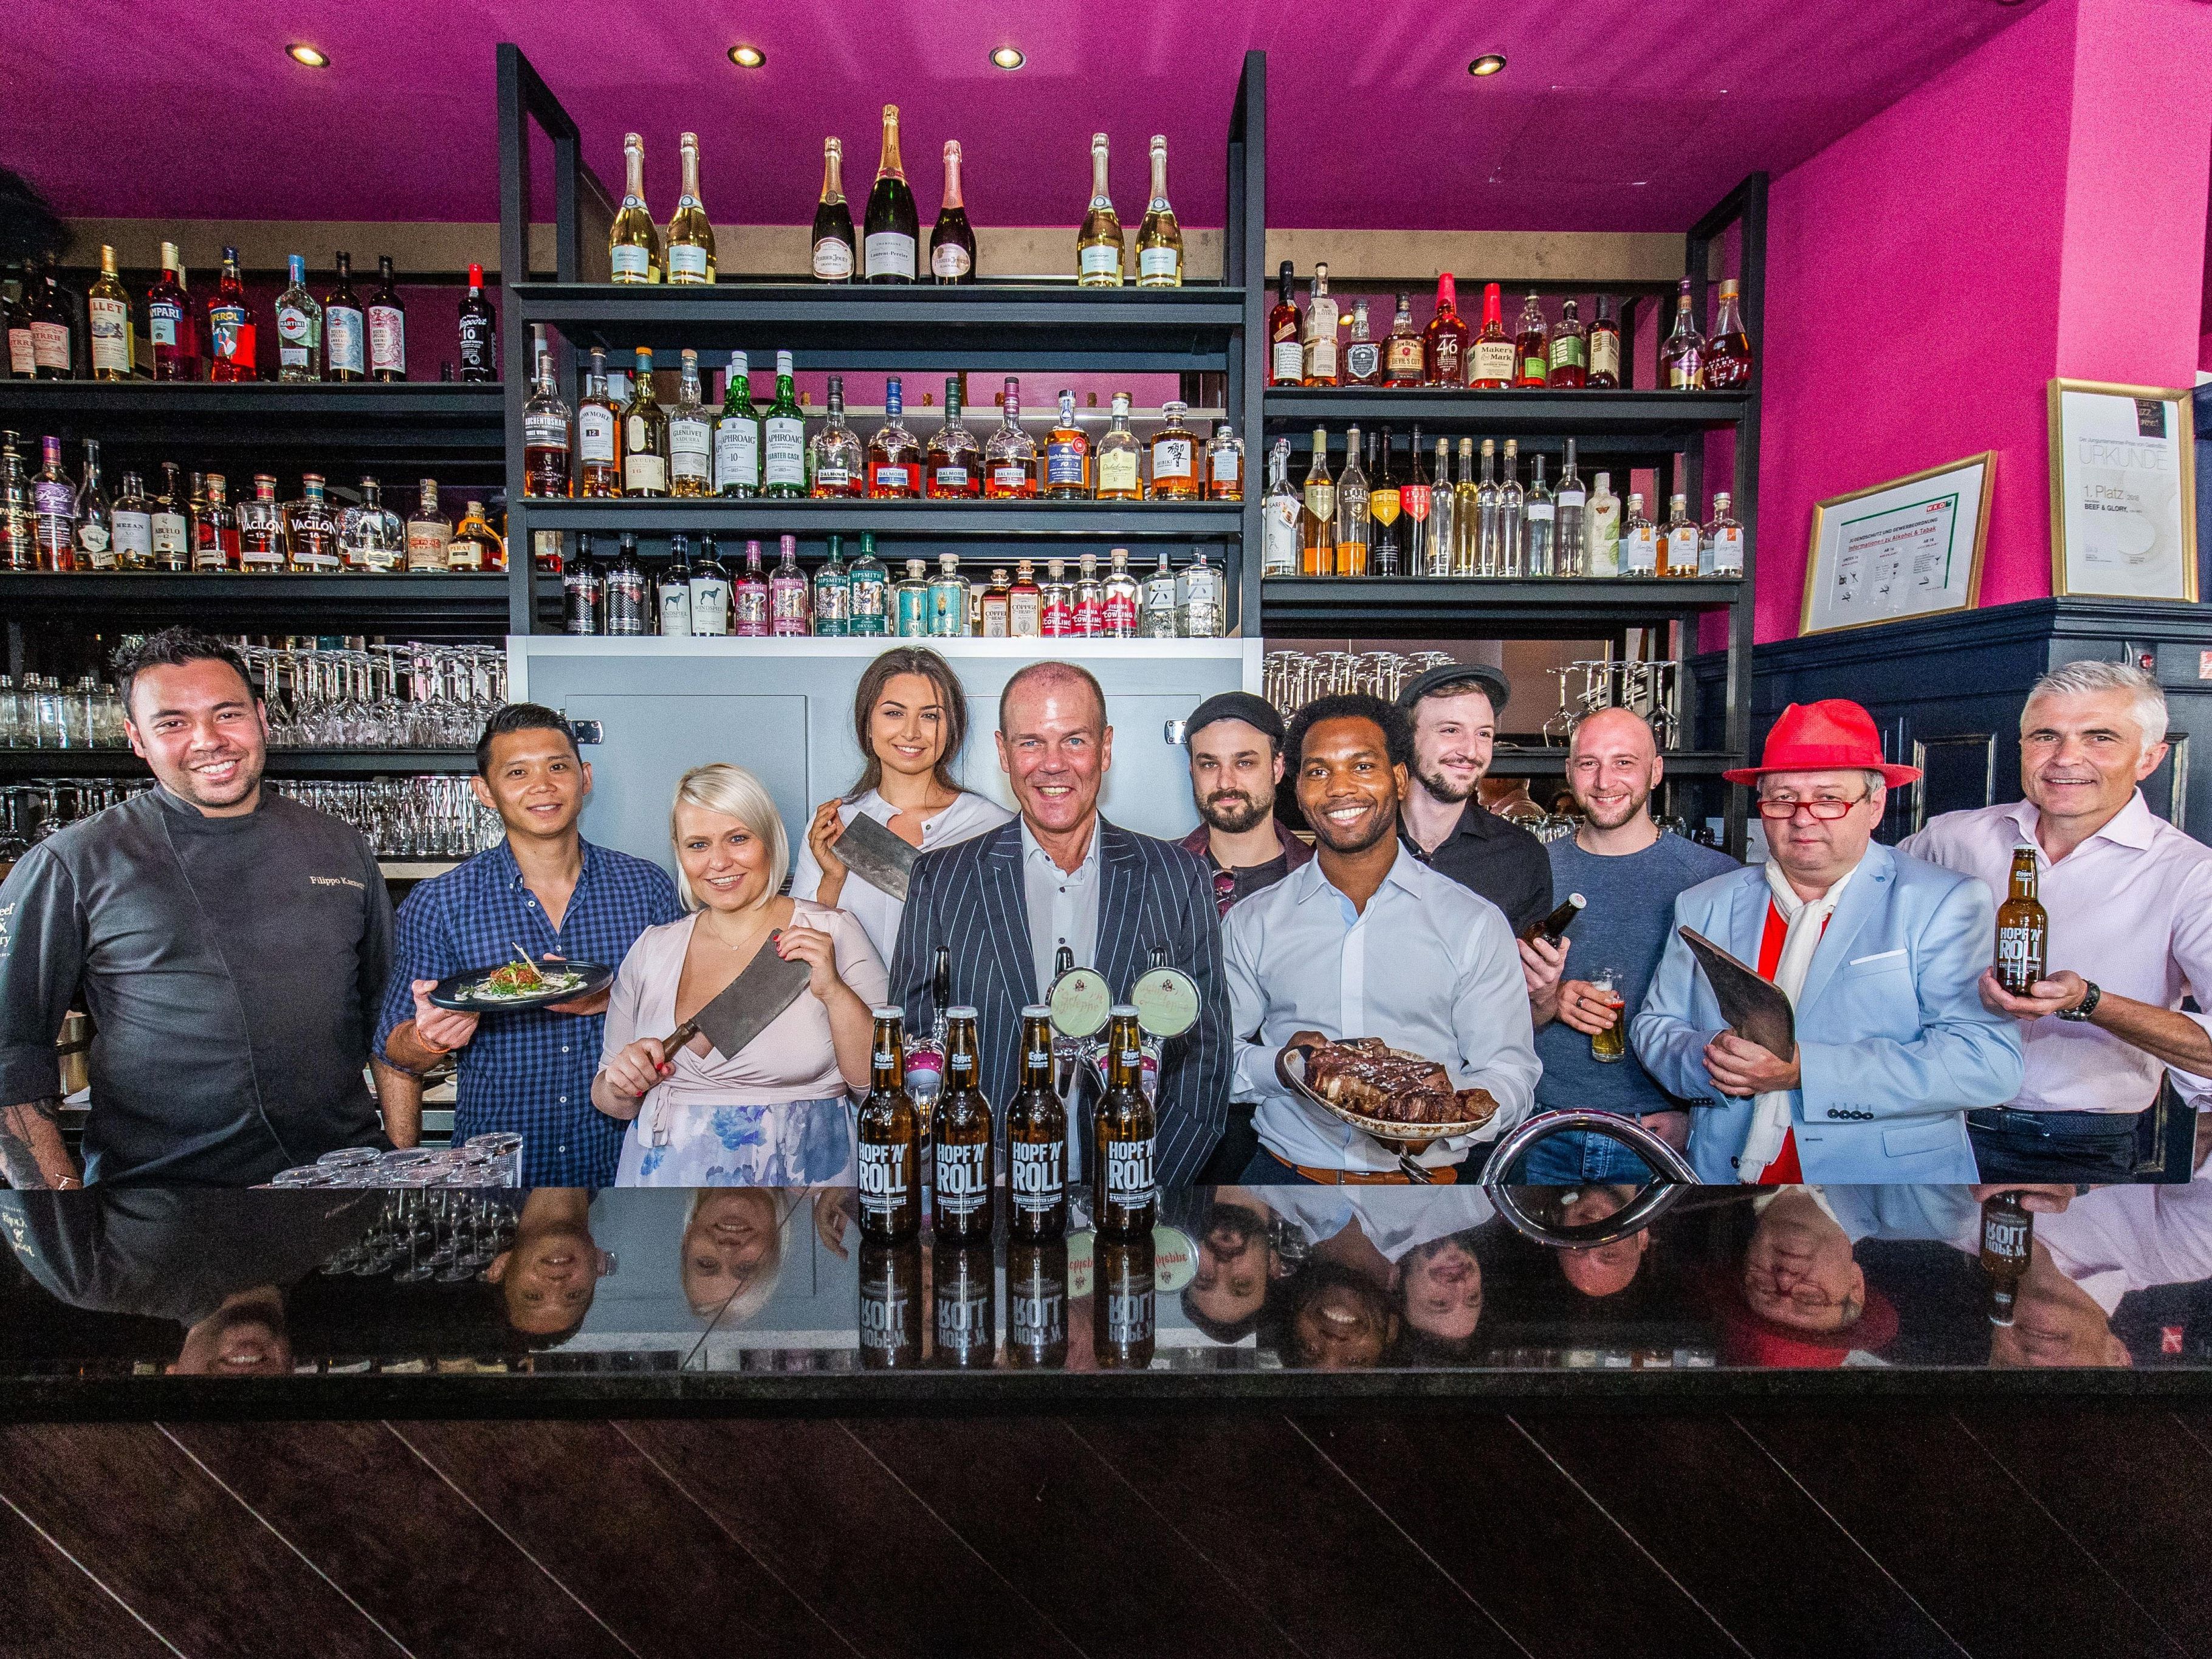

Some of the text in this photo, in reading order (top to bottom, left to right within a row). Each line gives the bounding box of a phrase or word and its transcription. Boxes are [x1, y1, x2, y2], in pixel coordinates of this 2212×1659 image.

[463, 329, 475, 340] 10
[1437, 338, 1458, 355] 46
[1705, 360, 1736, 371] OTARD
[525, 416, 566, 427] AUCHENTOSHAN
[673, 429, 702, 438] GLENLIVET
[730, 453, 738, 461] 10
[787, 452, 800, 461] CASK
[2079, 443, 2168, 470] URKUNDE
[2084, 484, 2092, 497] 1.
[2095, 485, 2124, 500] Platz
[1927, 501, 1945, 512] WKO
[1849, 531, 1882, 543] JUGENDSCHUTZ
[1892, 517, 1939, 533] GEWERBEORDNUNG
[1848, 538, 1884, 551] Informationen
[1892, 531, 1913, 541] Alkohol
[1920, 524, 1937, 534] Tabak
[564, 575, 599, 586] BROCKMANS
[608, 572, 643, 585] BROCKMANS
[309, 876, 340, 886] Filippo
[2000, 927, 2029, 940] HOPF
[1999, 939, 2041, 961] ROLL
[874, 1053, 894, 1062] Egger
[952, 1053, 972, 1063] Egger
[1028, 1051, 1048, 1061] Egger
[1122, 1050, 1139, 1060] Egger
[859, 1141, 889, 1163] HOPF
[936, 1142, 970, 1163] HOPF
[1012, 1141, 1048, 1162] HOPF
[1108, 1140, 1145, 1160] HOPF
[859, 1161, 907, 1194] ROLL
[936, 1161, 987, 1194] ROLL
[1012, 1159, 1063, 1192] ROLL
[1108, 1156, 1155, 1190] ROLL
